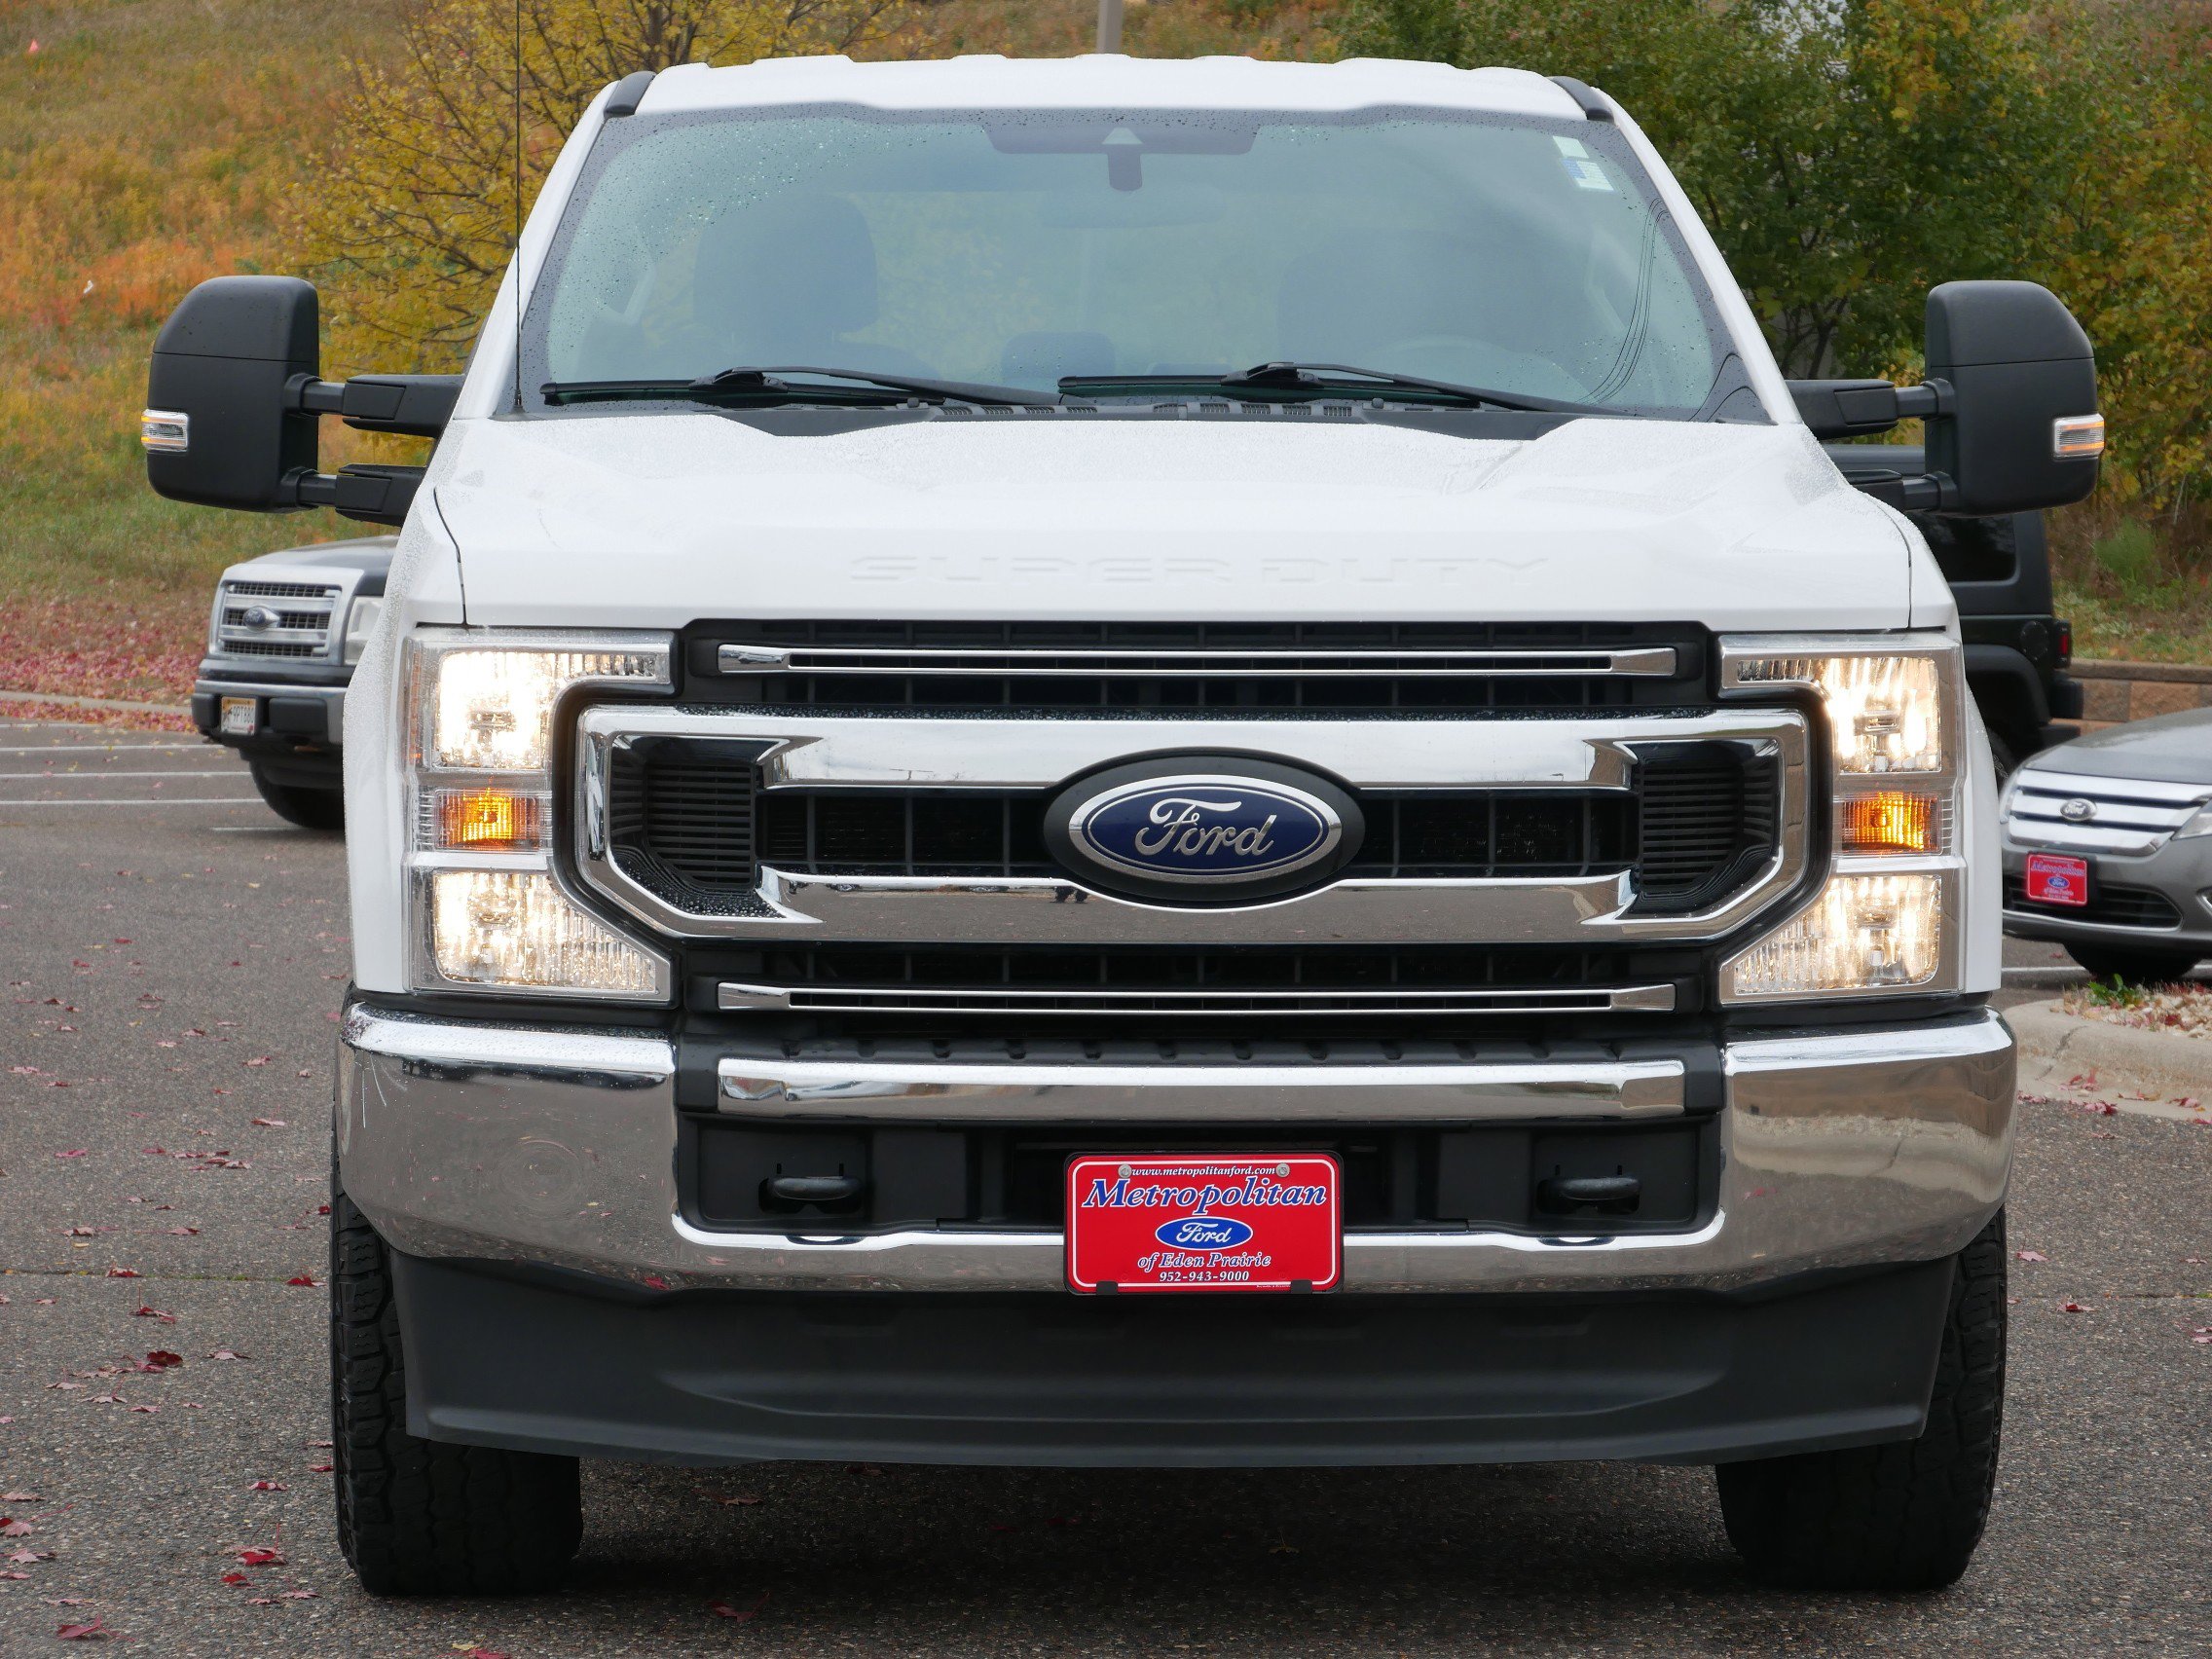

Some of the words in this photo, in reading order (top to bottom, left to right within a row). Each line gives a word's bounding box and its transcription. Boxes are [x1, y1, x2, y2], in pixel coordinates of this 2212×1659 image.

[850, 556, 1232, 583] SUPER
[1260, 556, 1549, 583] DUTY
[1134, 797, 1277, 856] Ford
[1131, 1165, 1275, 1178] www.metropolitanford.com
[1081, 1176, 1327, 1215] Metropolitan
[1176, 1222, 1232, 1243] Ford
[1138, 1253, 1160, 1272] of
[1159, 1252, 1204, 1268] Eden
[1208, 1252, 1272, 1268] Prairie
[1159, 1272, 1249, 1282] 952-943-9000
